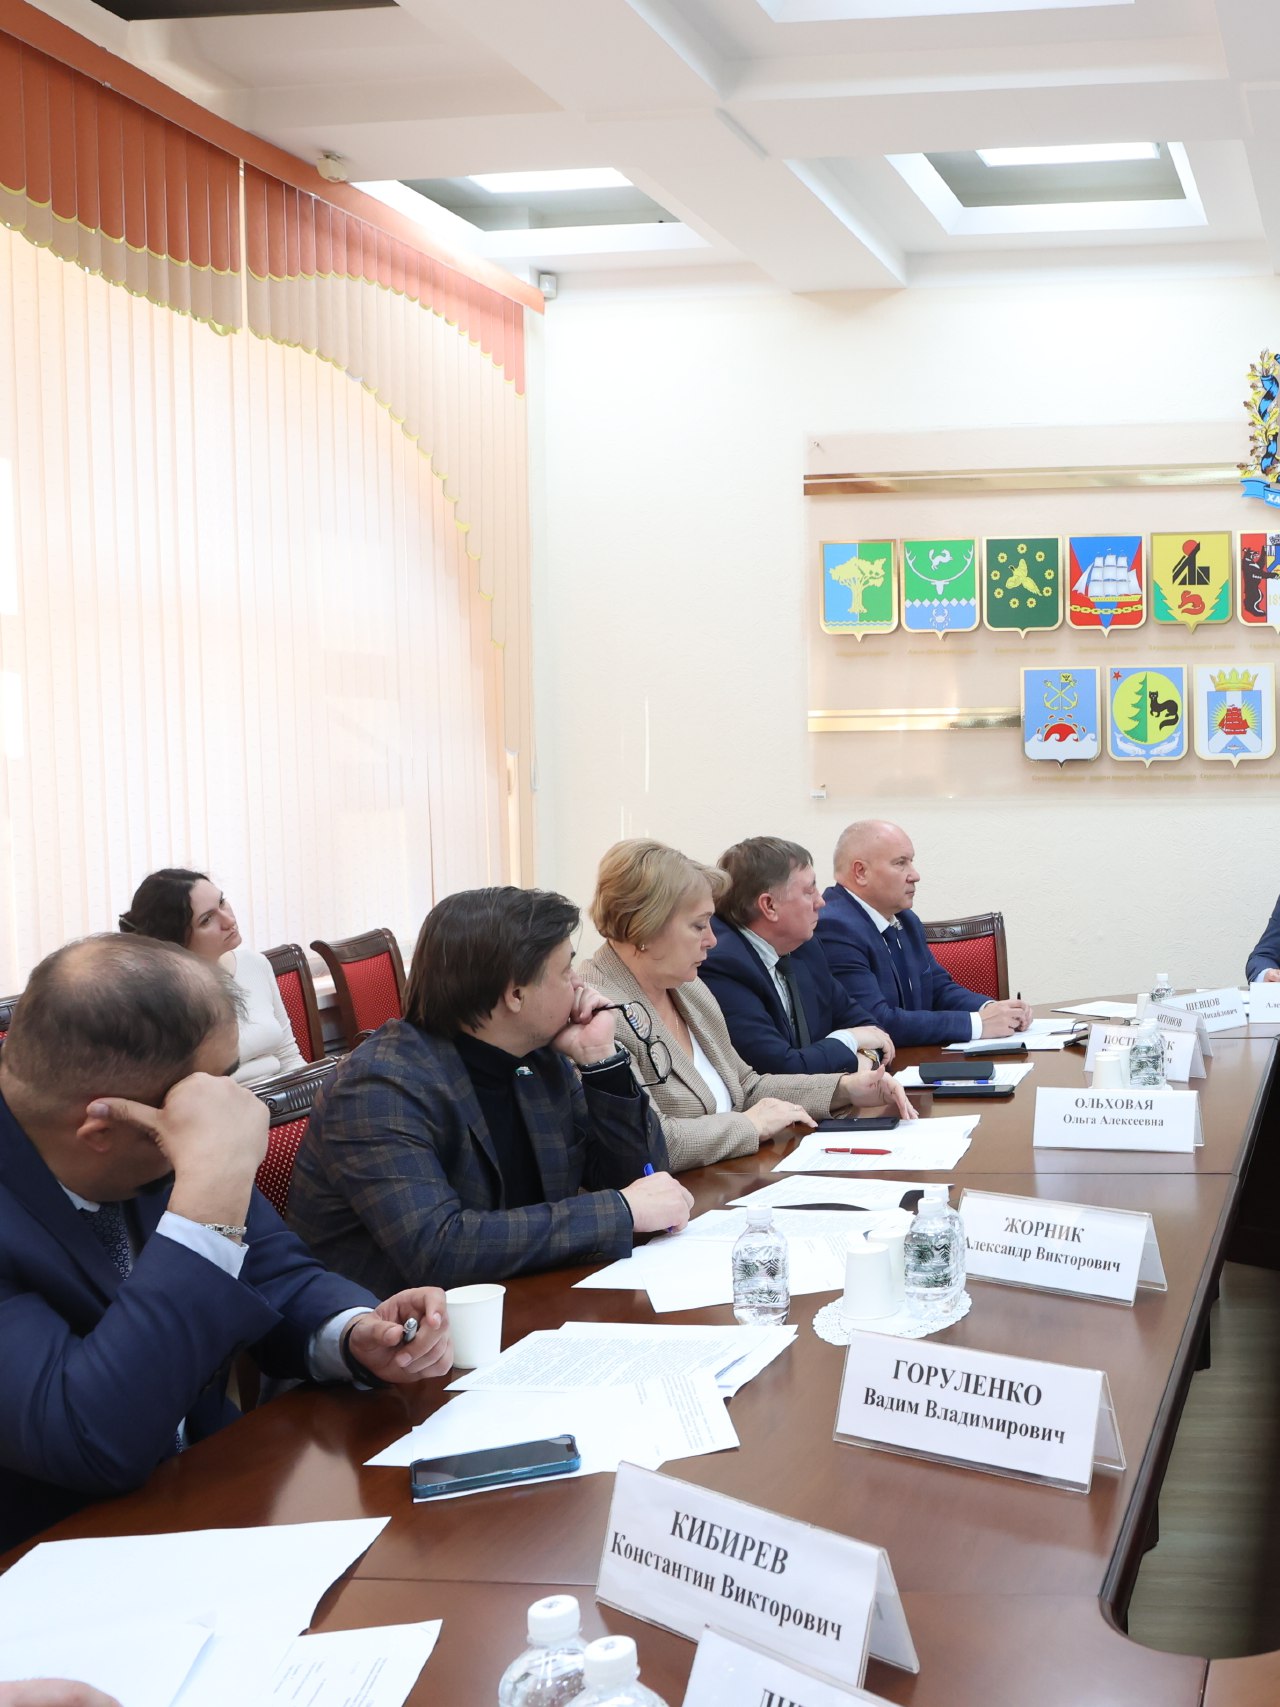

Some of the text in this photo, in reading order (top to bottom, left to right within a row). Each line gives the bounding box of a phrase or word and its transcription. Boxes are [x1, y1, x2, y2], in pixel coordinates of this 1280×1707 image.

[1186, 998, 1220, 1011] ШЕВЦОВ
[1075, 1097, 1154, 1111] ОЛЬХОВАЯ
[1063, 1113, 1164, 1127] Ольга Алексеевна
[1003, 1216, 1085, 1243] ЖОРНИК
[1035, 1246, 1121, 1272] Викторович
[892, 1359, 1043, 1406] ГОРУЛЕНКО
[863, 1387, 1066, 1444] Вадим Владимирович
[670, 1510, 789, 1575] КИБИРЕВ
[610, 1531, 843, 1641] Константин Викторович
